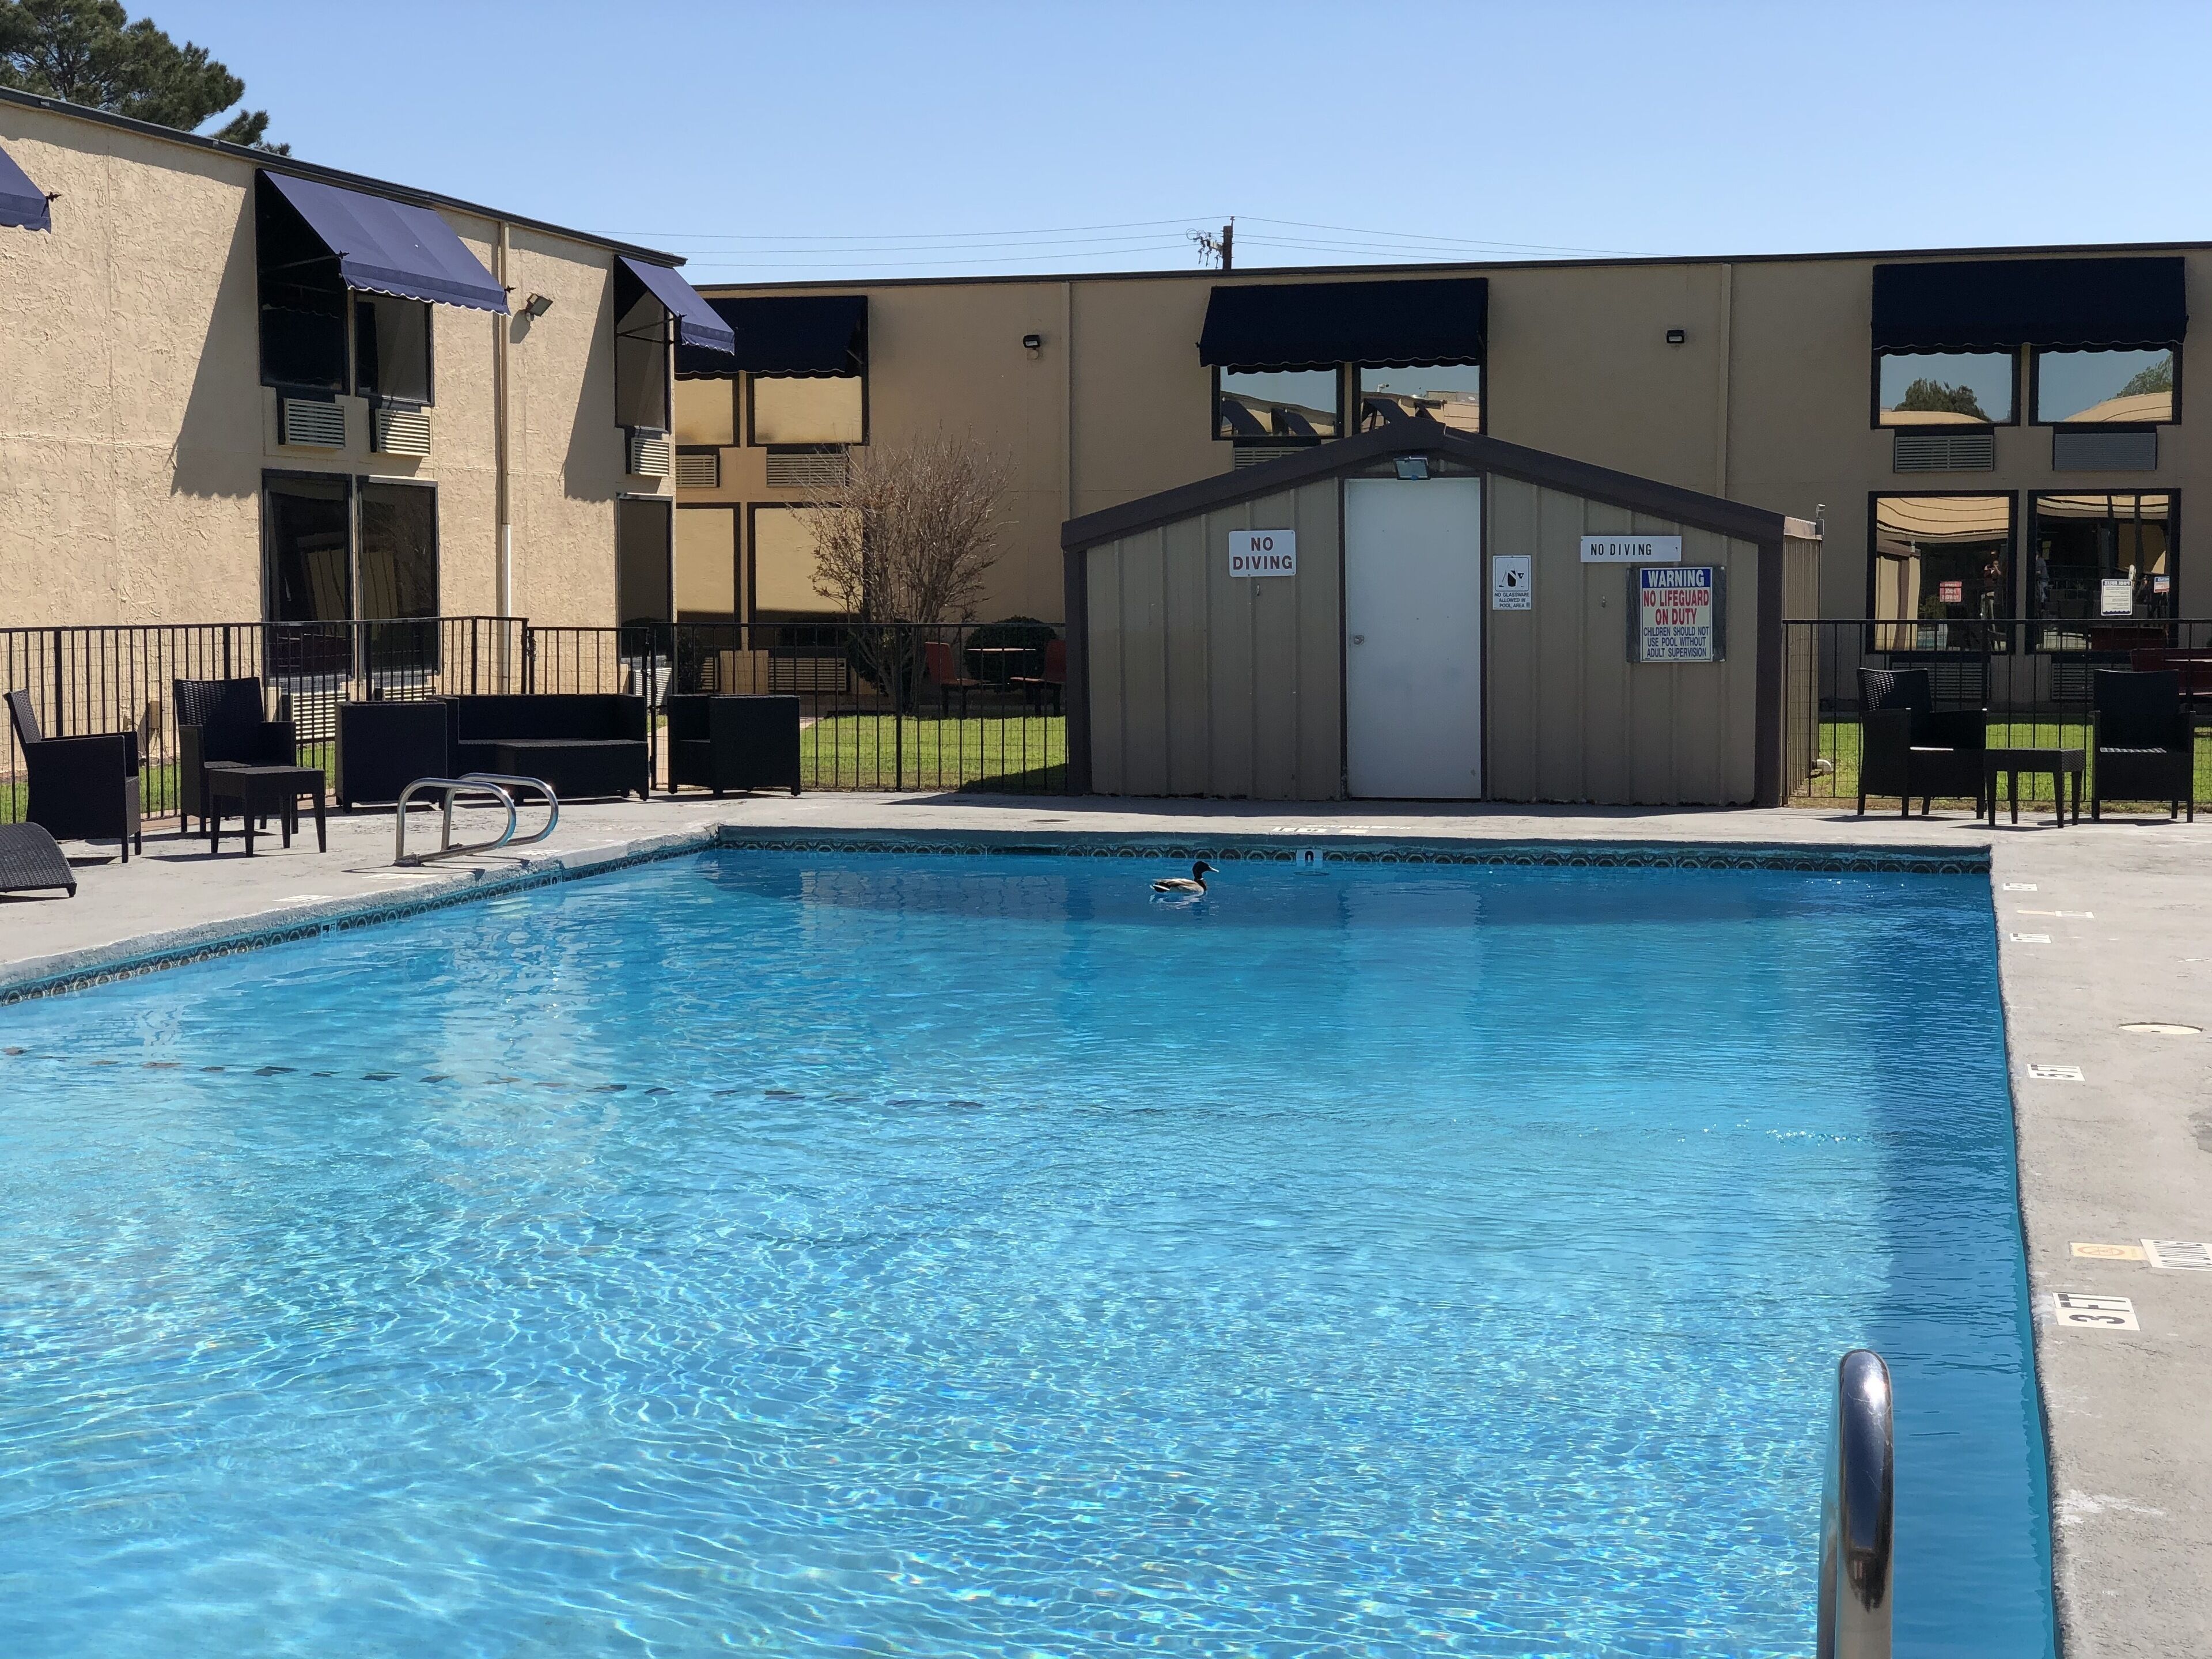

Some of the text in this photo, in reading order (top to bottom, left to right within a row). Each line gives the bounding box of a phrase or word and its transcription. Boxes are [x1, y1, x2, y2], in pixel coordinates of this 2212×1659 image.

[1251, 537, 1274, 551] NO
[1590, 543, 1652, 556] NO DIVING
[1233, 555, 1293, 570] DIVING
[1647, 570, 1705, 588] WARNING
[1643, 589, 1709, 607] NO LIFEGUARD
[1656, 608, 1697, 625] ON DUTY
[1644, 626, 1709, 637] CHILDREN SHOULD NOT
[1647, 637, 1706, 647] USE POOL WITHOUT
[1647, 647, 1707, 657] ADULT SUPERVISION
[2031, 1064, 2078, 1073] FT
[2058, 1293, 2130, 1324] 3 FT
